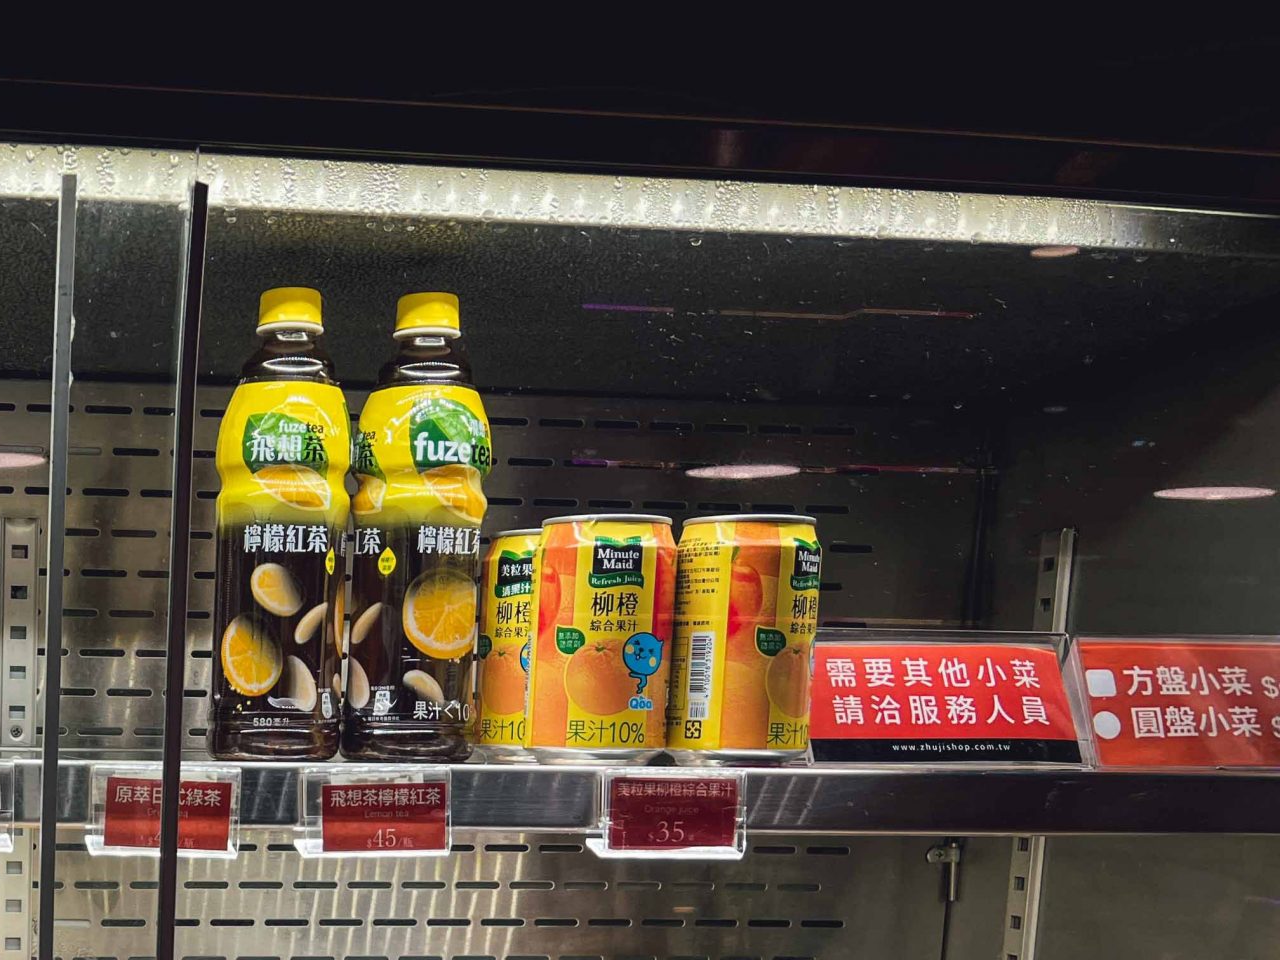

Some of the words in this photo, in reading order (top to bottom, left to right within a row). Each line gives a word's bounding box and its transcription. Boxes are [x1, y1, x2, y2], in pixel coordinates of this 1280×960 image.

[250, 434, 325, 463] 飛想茶
[244, 525, 328, 553] 檸檬紅茶
[597, 548, 640, 561] Minute
[602, 558, 634, 570] Maid
[501, 563, 532, 577] 美粒果
[591, 591, 638, 617] 柳橙
[590, 620, 638, 632] 綜合果汁
[825, 657, 1040, 689] 需要其他小菜
[1126, 666, 1253, 696] 方盤小菜
[253, 717, 272, 727] 580
[833, 695, 1050, 726] 請洽服務人員
[1132, 706, 1262, 738] 圓盤小菜
[566, 720, 645, 743] 果汁10%
[330, 787, 441, 808] 飛想茶檸檬紅茶
